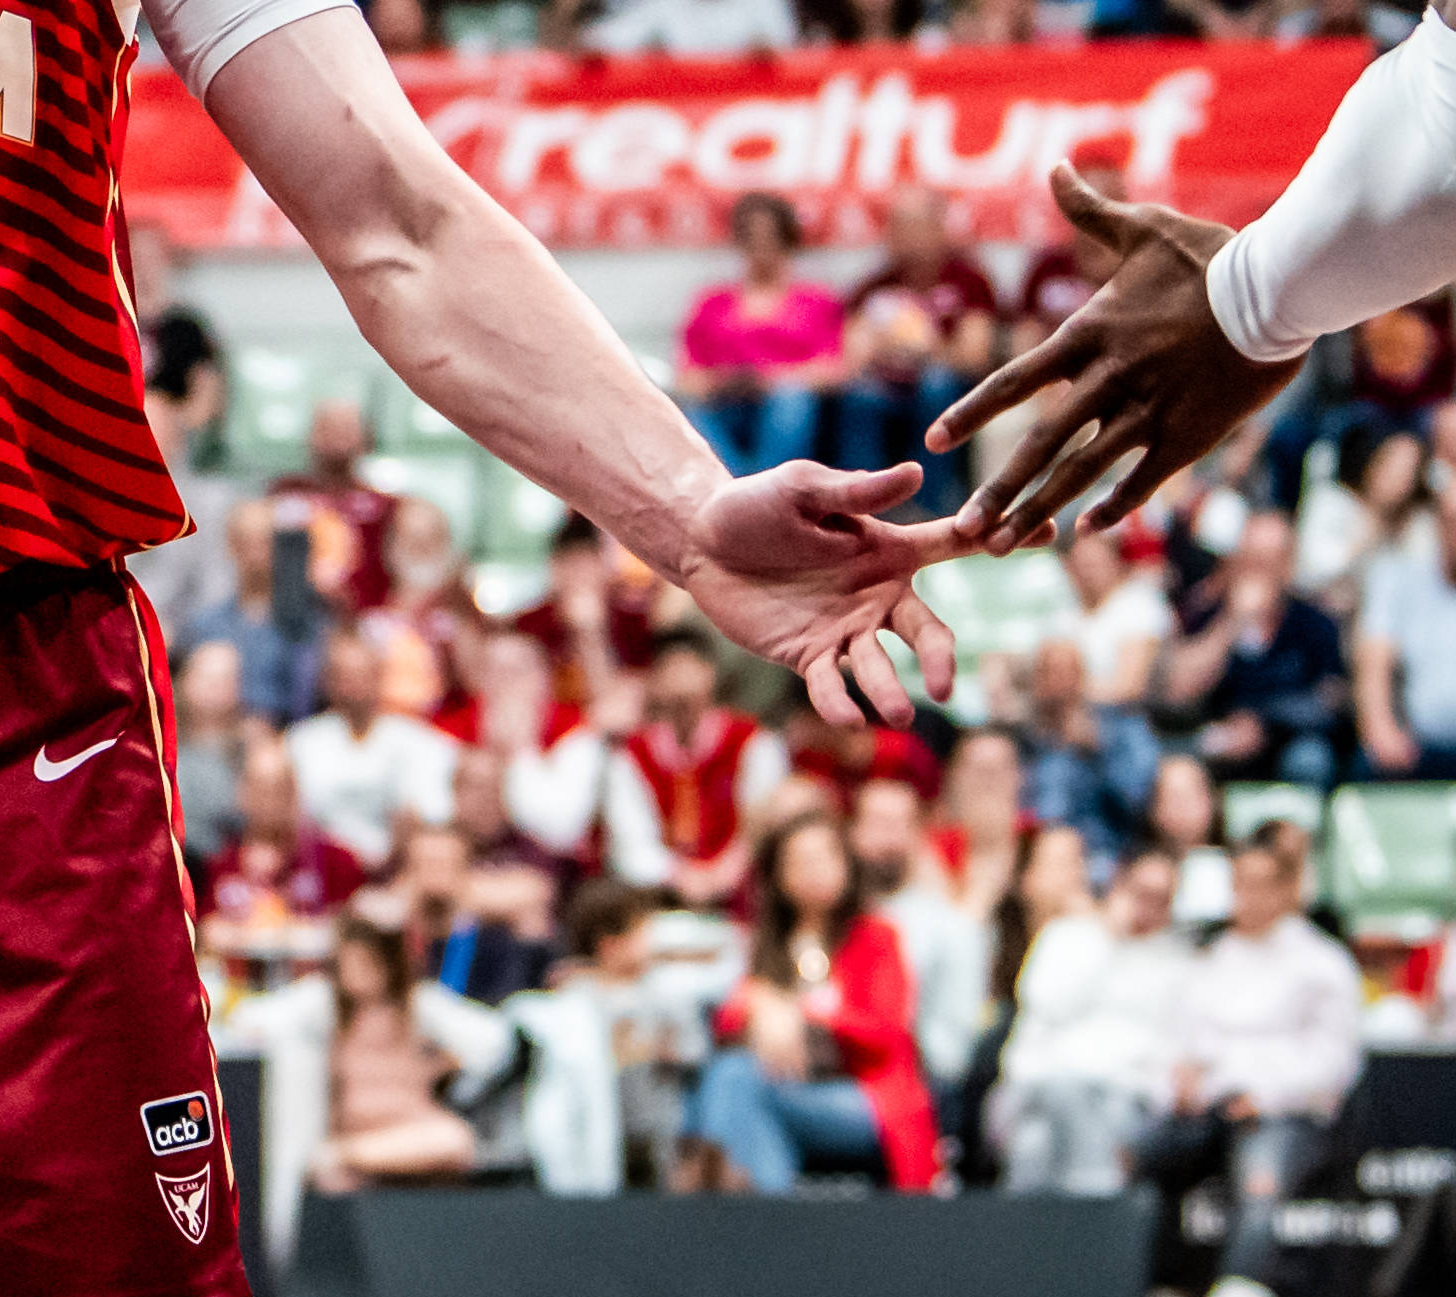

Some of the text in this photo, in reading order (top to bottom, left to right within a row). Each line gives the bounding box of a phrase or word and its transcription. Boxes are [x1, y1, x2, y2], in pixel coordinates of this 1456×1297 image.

[491, 70, 1213, 190] realturf
[155, 1117, 199, 1147] acb
[173, 1182, 200, 1194] UCAM
